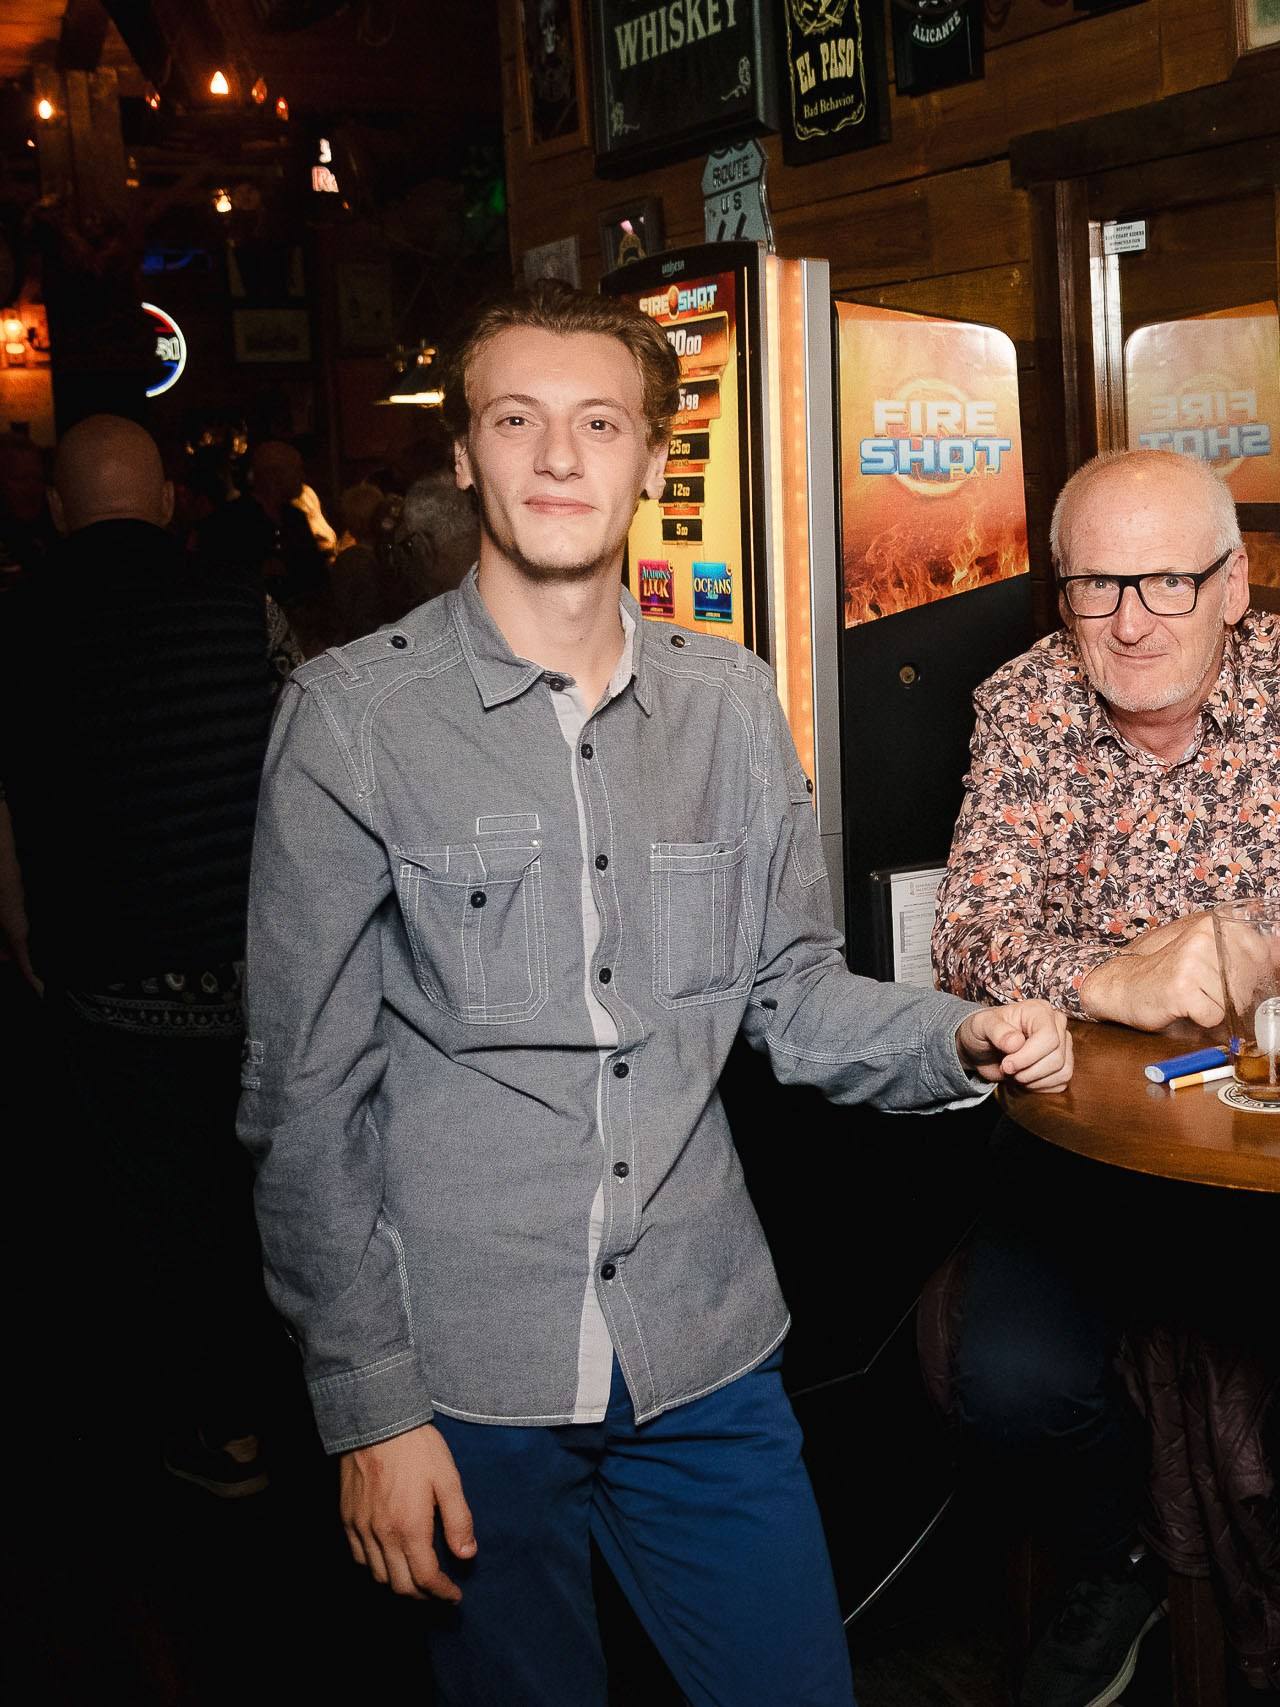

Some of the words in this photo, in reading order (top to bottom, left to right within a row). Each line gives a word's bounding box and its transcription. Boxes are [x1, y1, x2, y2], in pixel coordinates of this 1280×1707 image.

[614, 0, 737, 70] WHISKEY
[912, 10, 961, 43] ALICANTE
[796, 51, 816, 95] EL
[819, 38, 855, 81] PASO
[803, 104, 819, 119] Bad
[820, 94, 855, 113] Behavior
[713, 160, 750, 188] ROUTE
[678, 284, 718, 312] SHOT
[874, 400, 998, 437] FIRE
[860, 438, 1011, 475] SHOT
[950, 464, 1001, 480] BAR
[643, 578, 669, 598] LUCK
[694, 577, 731, 594] OCEANS
